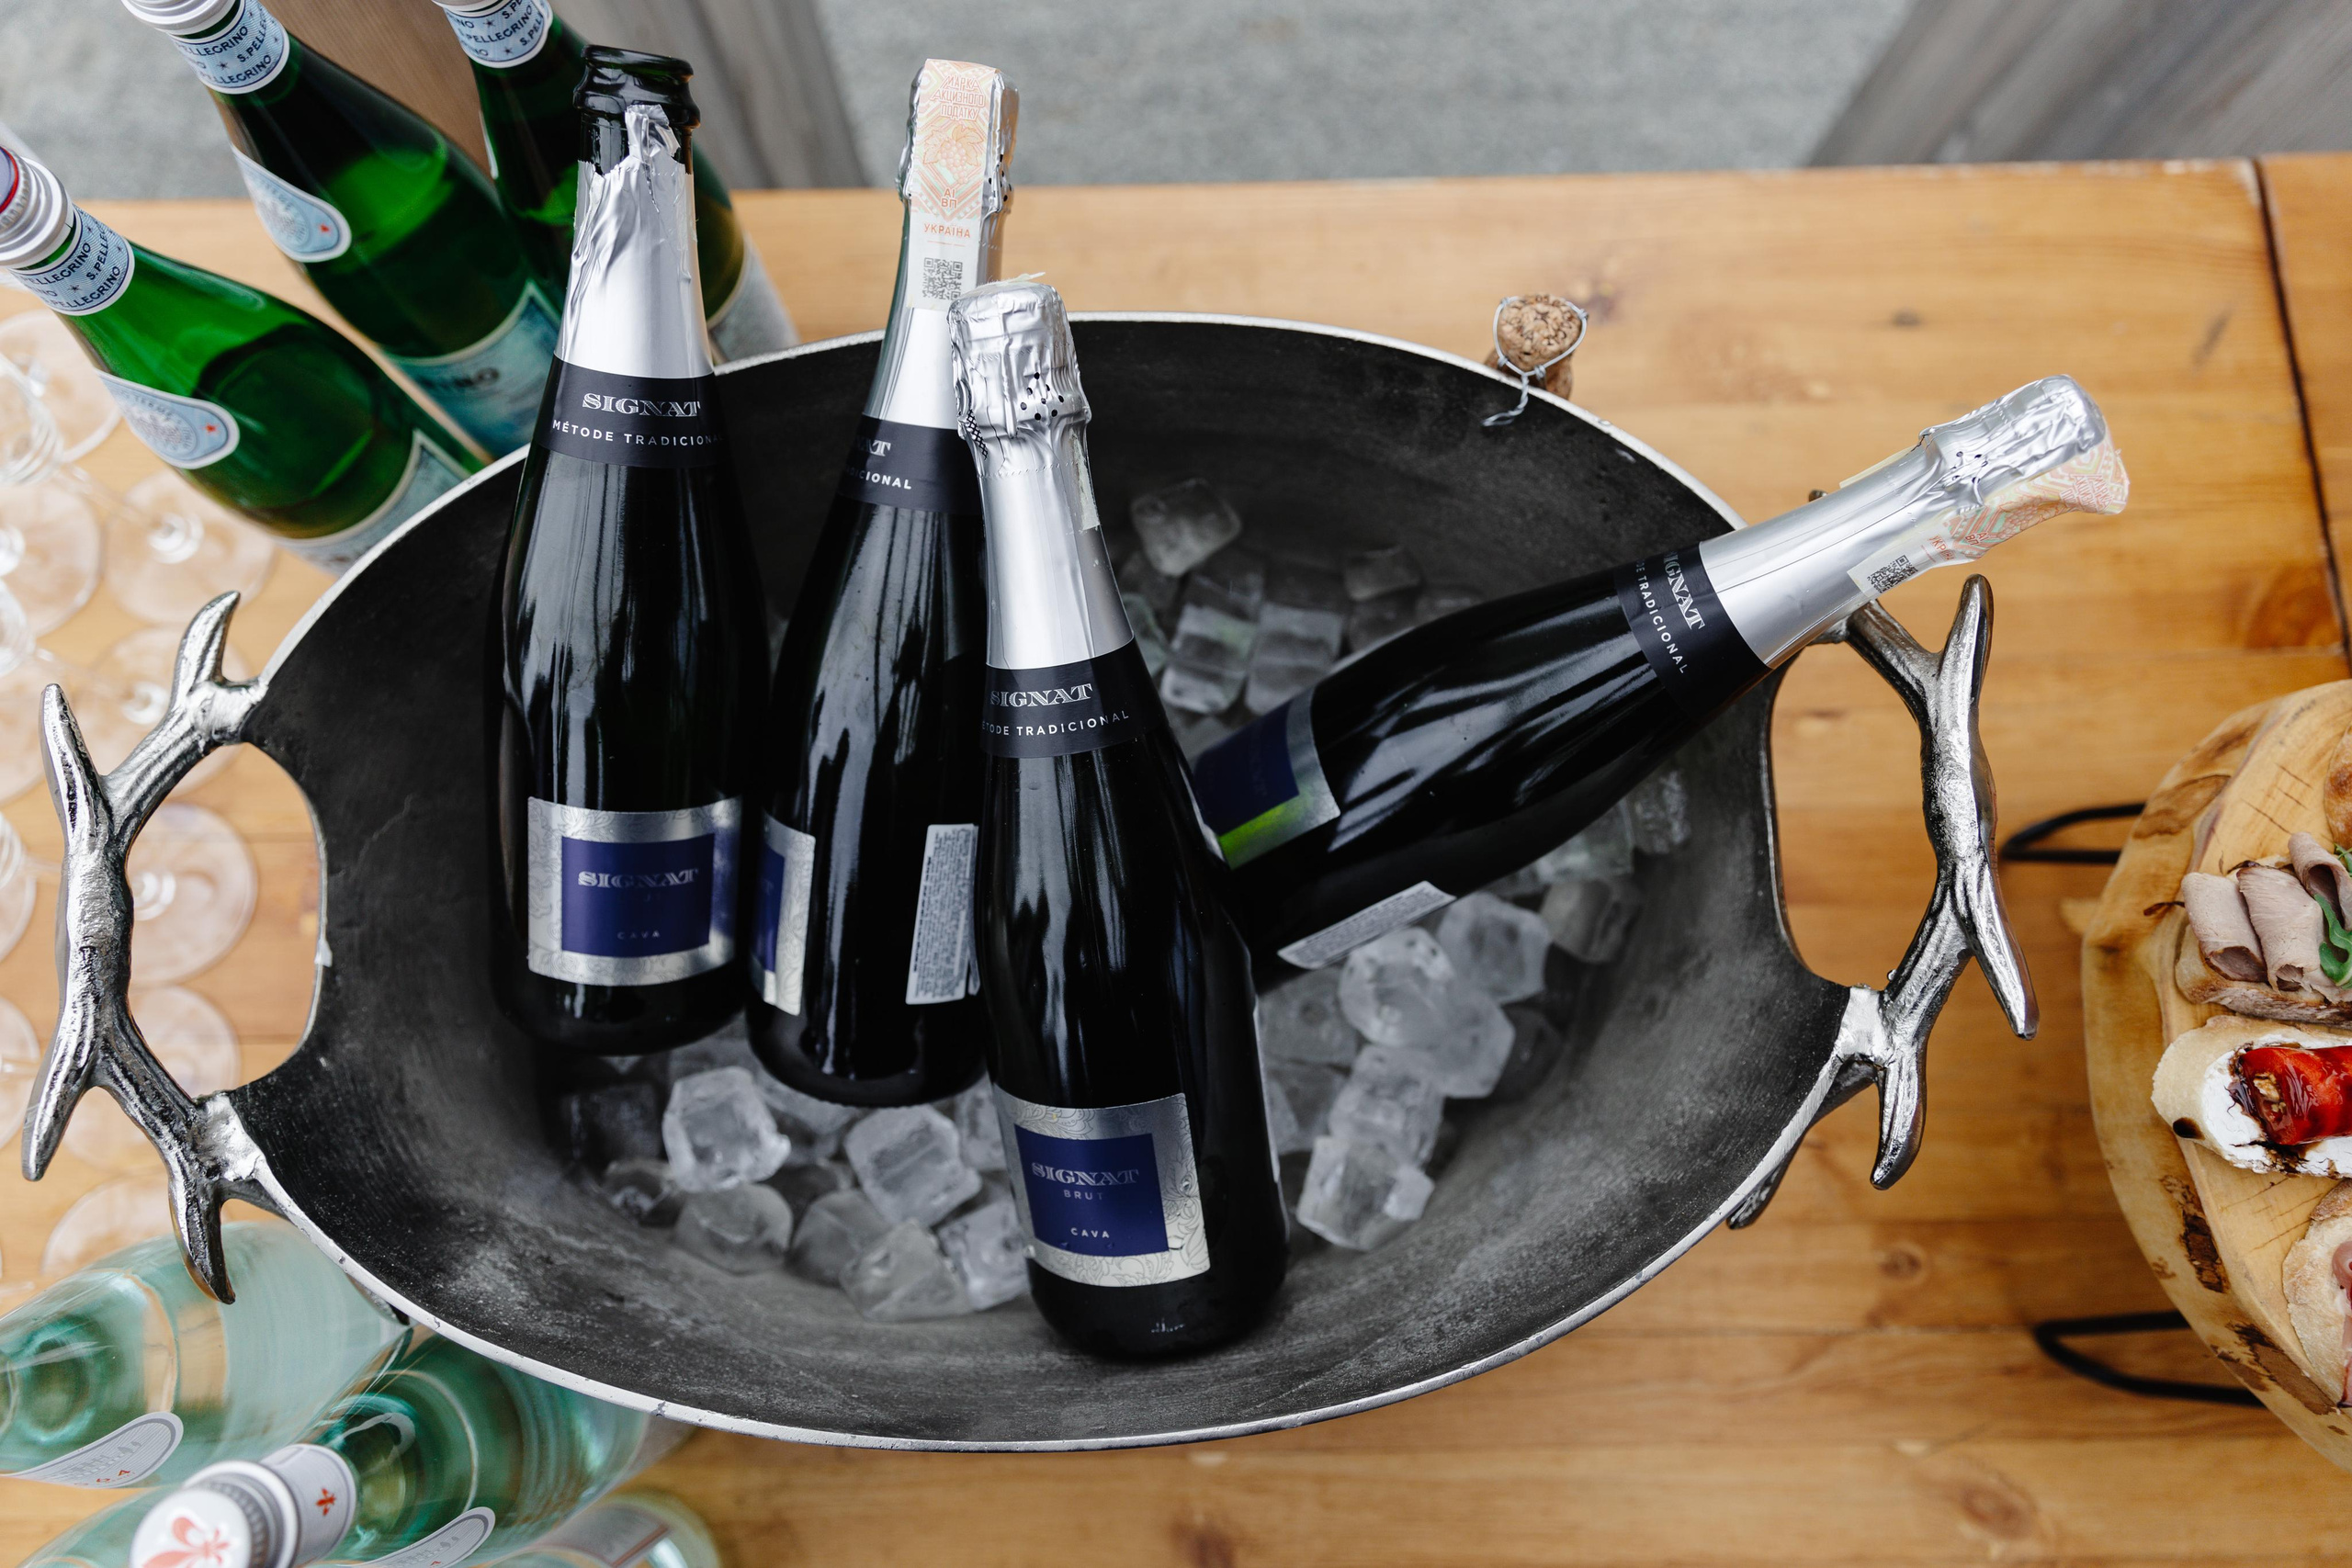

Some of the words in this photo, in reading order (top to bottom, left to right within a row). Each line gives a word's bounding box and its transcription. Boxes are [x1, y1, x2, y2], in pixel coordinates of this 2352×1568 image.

[941, 74, 983, 91] МАРКА
[930, 89, 986, 107] АКЦИЗНОГО
[941, 104, 980, 120] ПОДАТКУ
[924, 222, 971, 239] УКРАЇНА
[582, 392, 701, 418] SIGNAT
[552, 419, 614, 442] MÉTODE
[1636, 574, 1690, 674] TRADICIONAL
[989, 682, 1093, 707] SIGNAT
[1016, 710, 1130, 737] TRADICIONAL
[577, 868, 699, 889] SIGNAT
[616, 930, 661, 940] CAVA
[1031, 1161, 1140, 1187] SIGNAT
[1063, 1190, 1102, 1201] BRUT
[1070, 1226, 1111, 1239] CAVA
